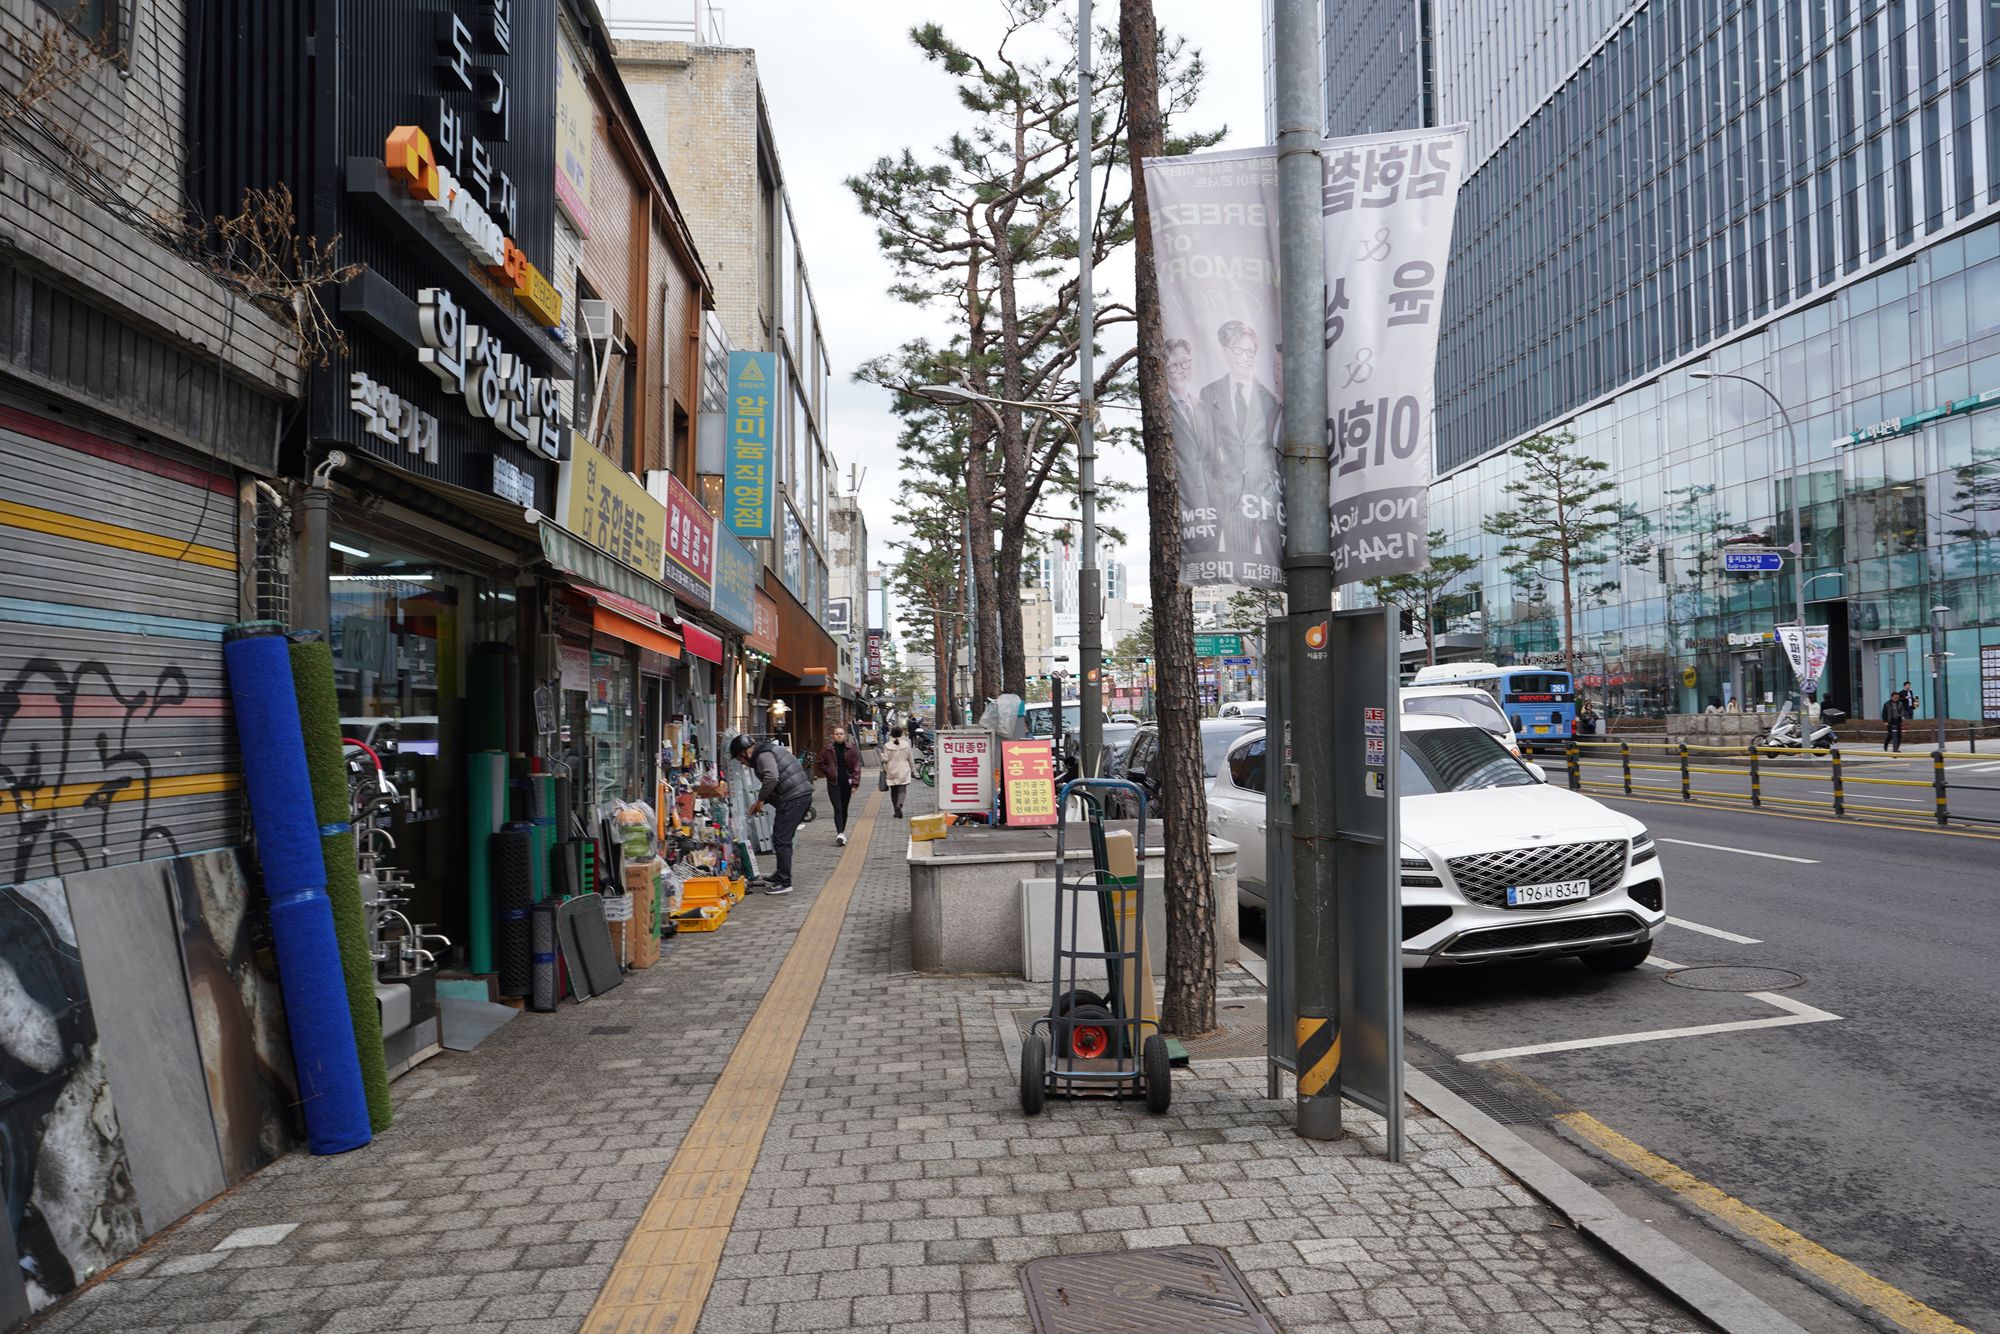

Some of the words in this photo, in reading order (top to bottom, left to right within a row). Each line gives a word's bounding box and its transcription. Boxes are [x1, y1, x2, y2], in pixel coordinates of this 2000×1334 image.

[440, 97, 517, 240] 바닥재
[430, 286, 561, 459] 희성산업
[351, 371, 439, 464] 착한가게
[1867, 417, 1900, 438] 하나은행
[733, 395, 768, 528] 알미늄직영점
[1728, 632, 1764, 647] Burger
[1552, 684, 1565, 693] 261
[943, 742, 987, 753] 현대종합
[1008, 760, 1050, 776] 공구
[951, 757, 980, 803] 볼트
[1518, 885, 1553, 900] 196서
[1556, 881, 1587, 898] 8347
